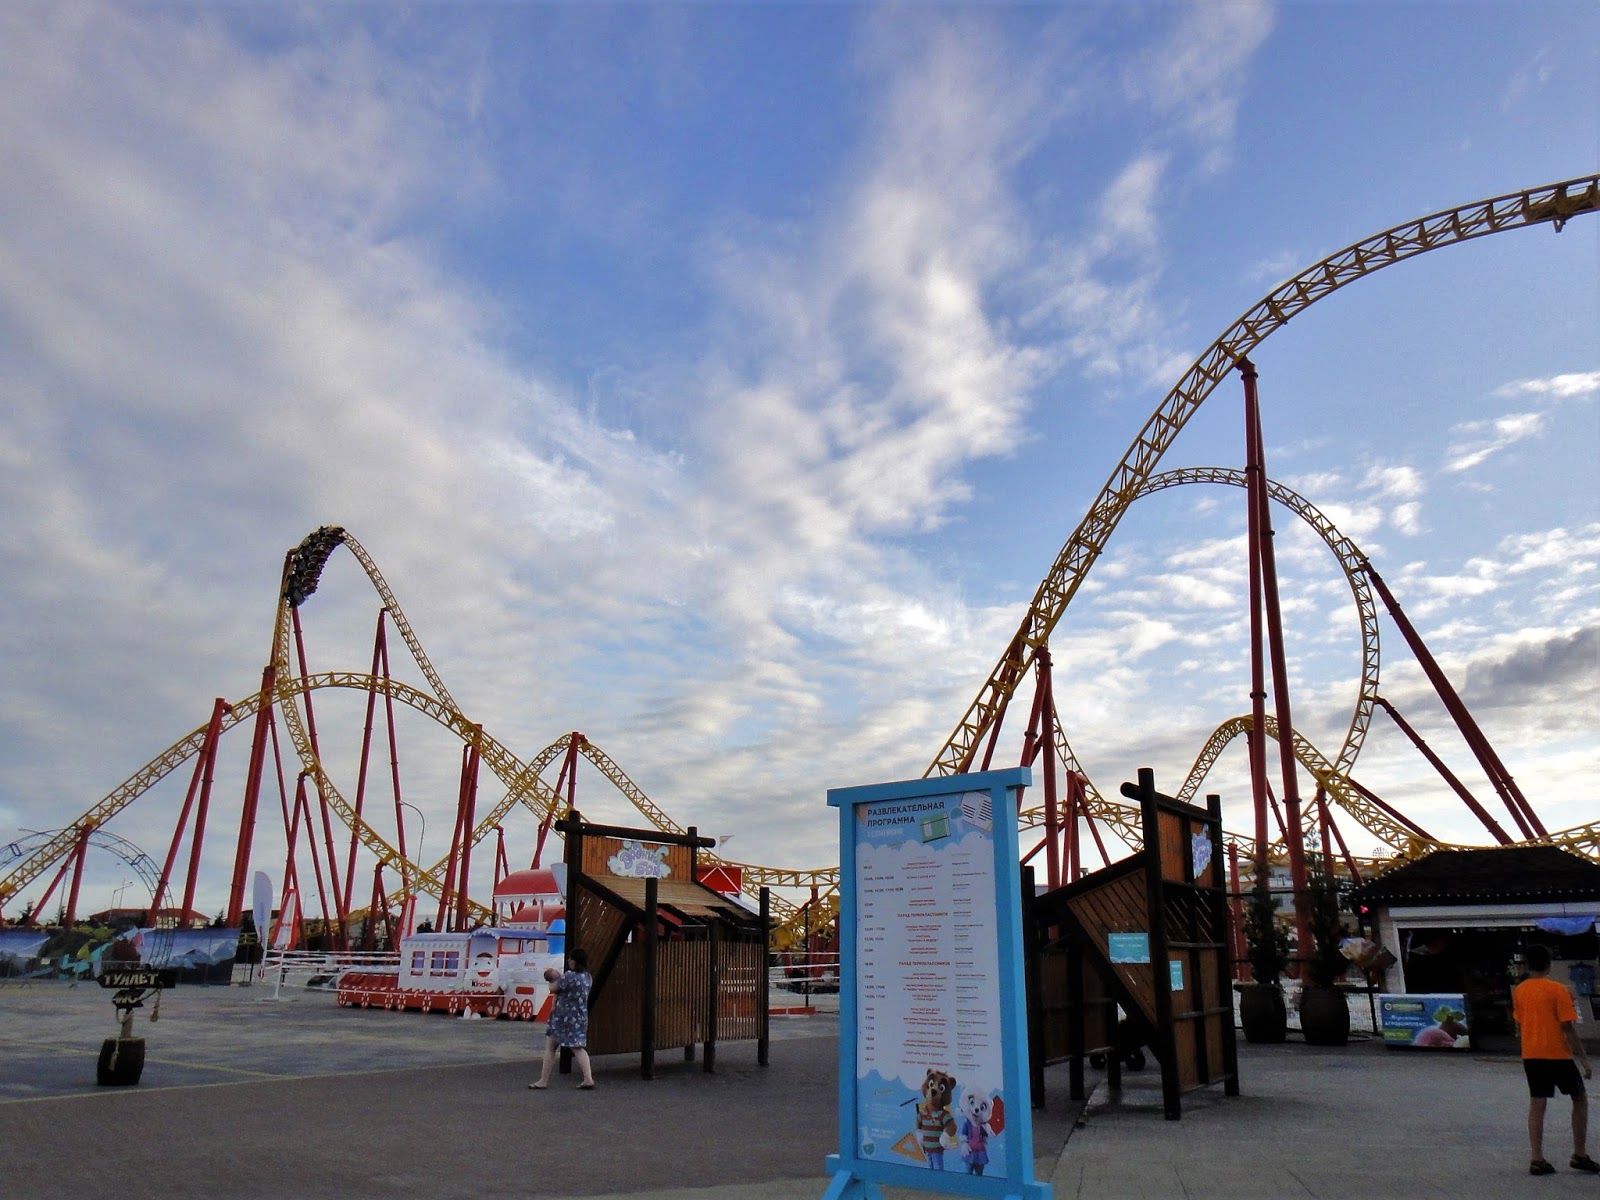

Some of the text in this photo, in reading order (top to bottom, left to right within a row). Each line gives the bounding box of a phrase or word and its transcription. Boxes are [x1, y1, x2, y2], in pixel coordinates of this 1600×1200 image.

[867, 801, 945, 817] РАЗВЛЕКАТЕЛЬНАЯ
[867, 816, 916, 828] ПРОГРАММА
[104, 972, 159, 986] ТУАЛЕТ
[471, 980, 493, 988] Kinder
